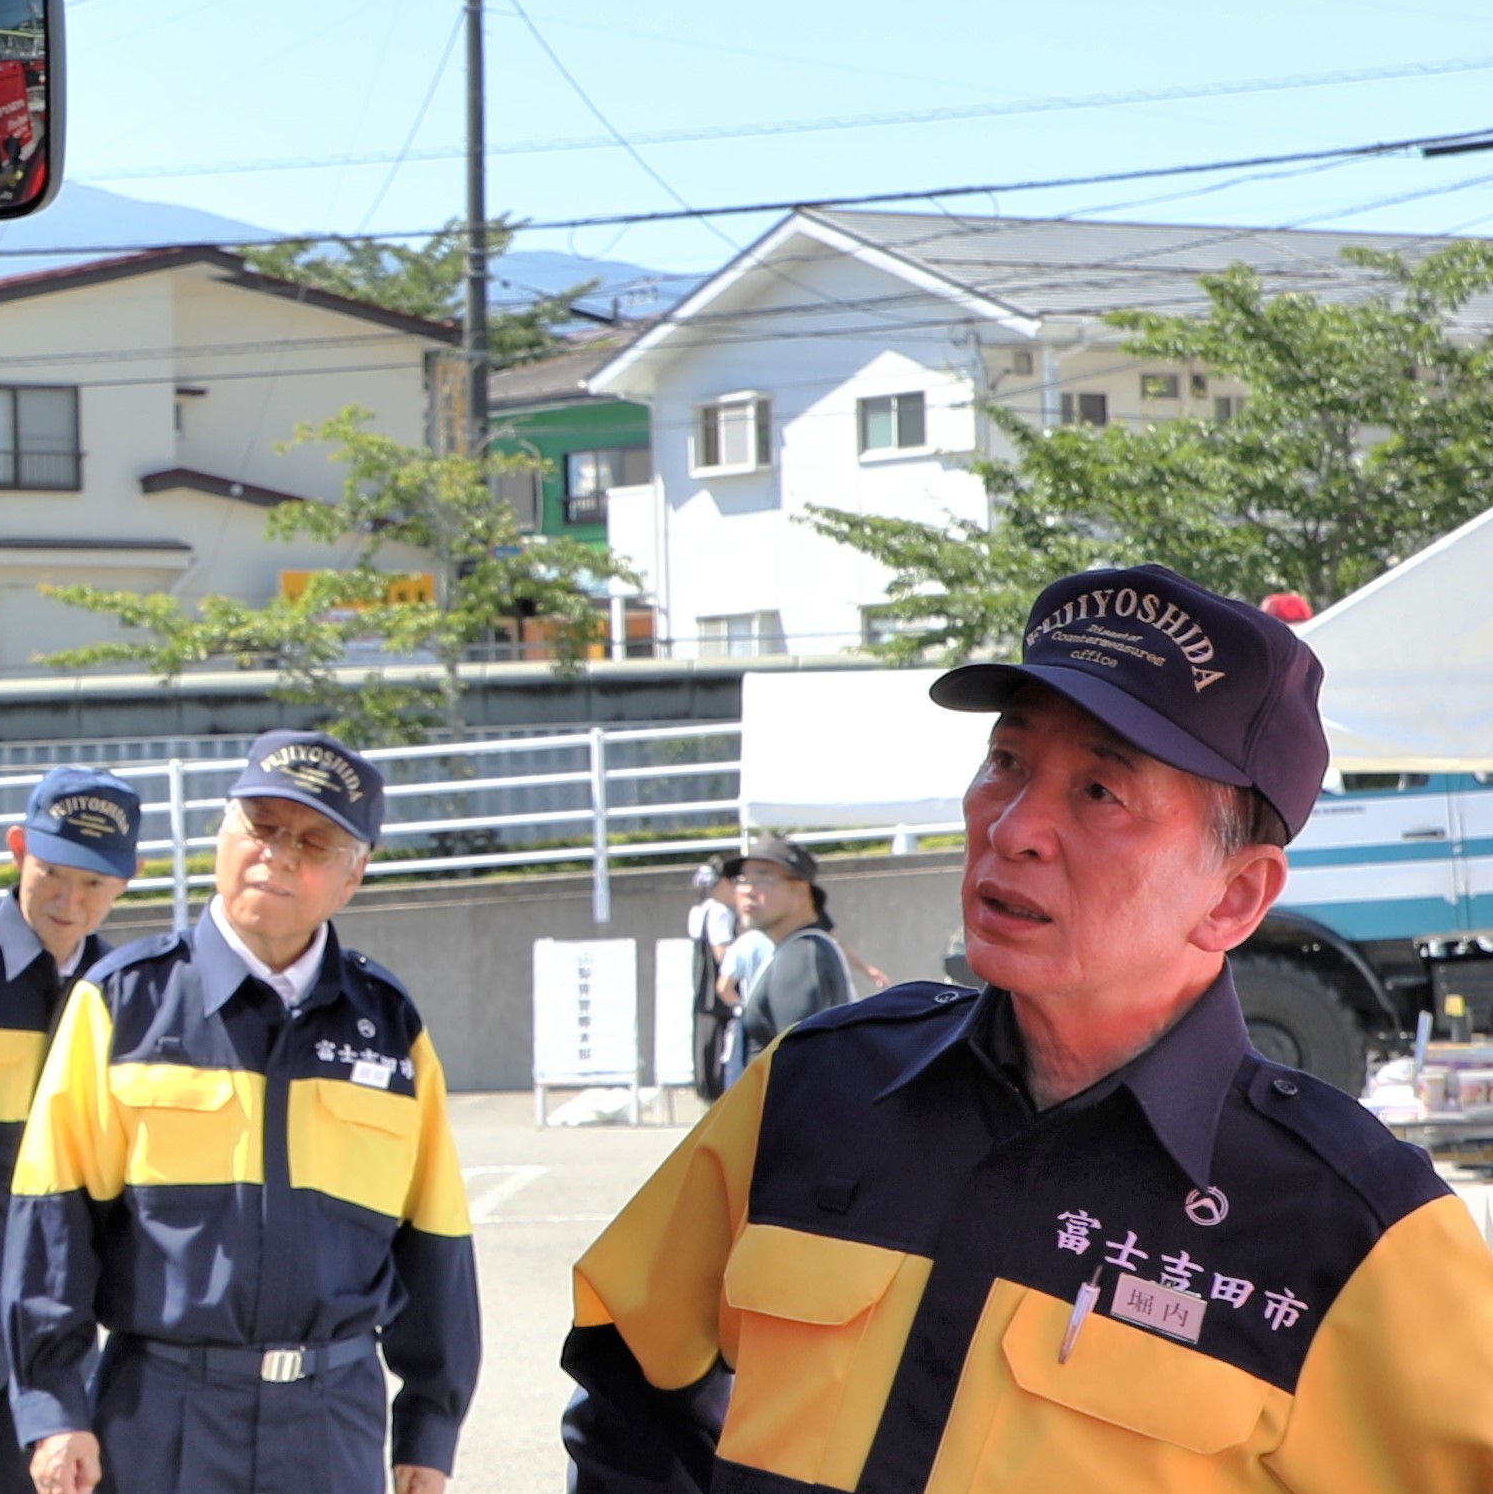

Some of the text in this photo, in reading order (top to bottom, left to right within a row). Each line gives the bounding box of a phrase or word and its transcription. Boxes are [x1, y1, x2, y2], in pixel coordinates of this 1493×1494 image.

[1025, 587, 1226, 693] FUJIYOSHIDA
[1050, 629, 1167, 668] Countermeasures
[1085, 623, 1144, 643] Disaster
[1057, 1209, 1309, 1331] 富士吉田市
[1127, 1287, 1189, 1329] 堀内
